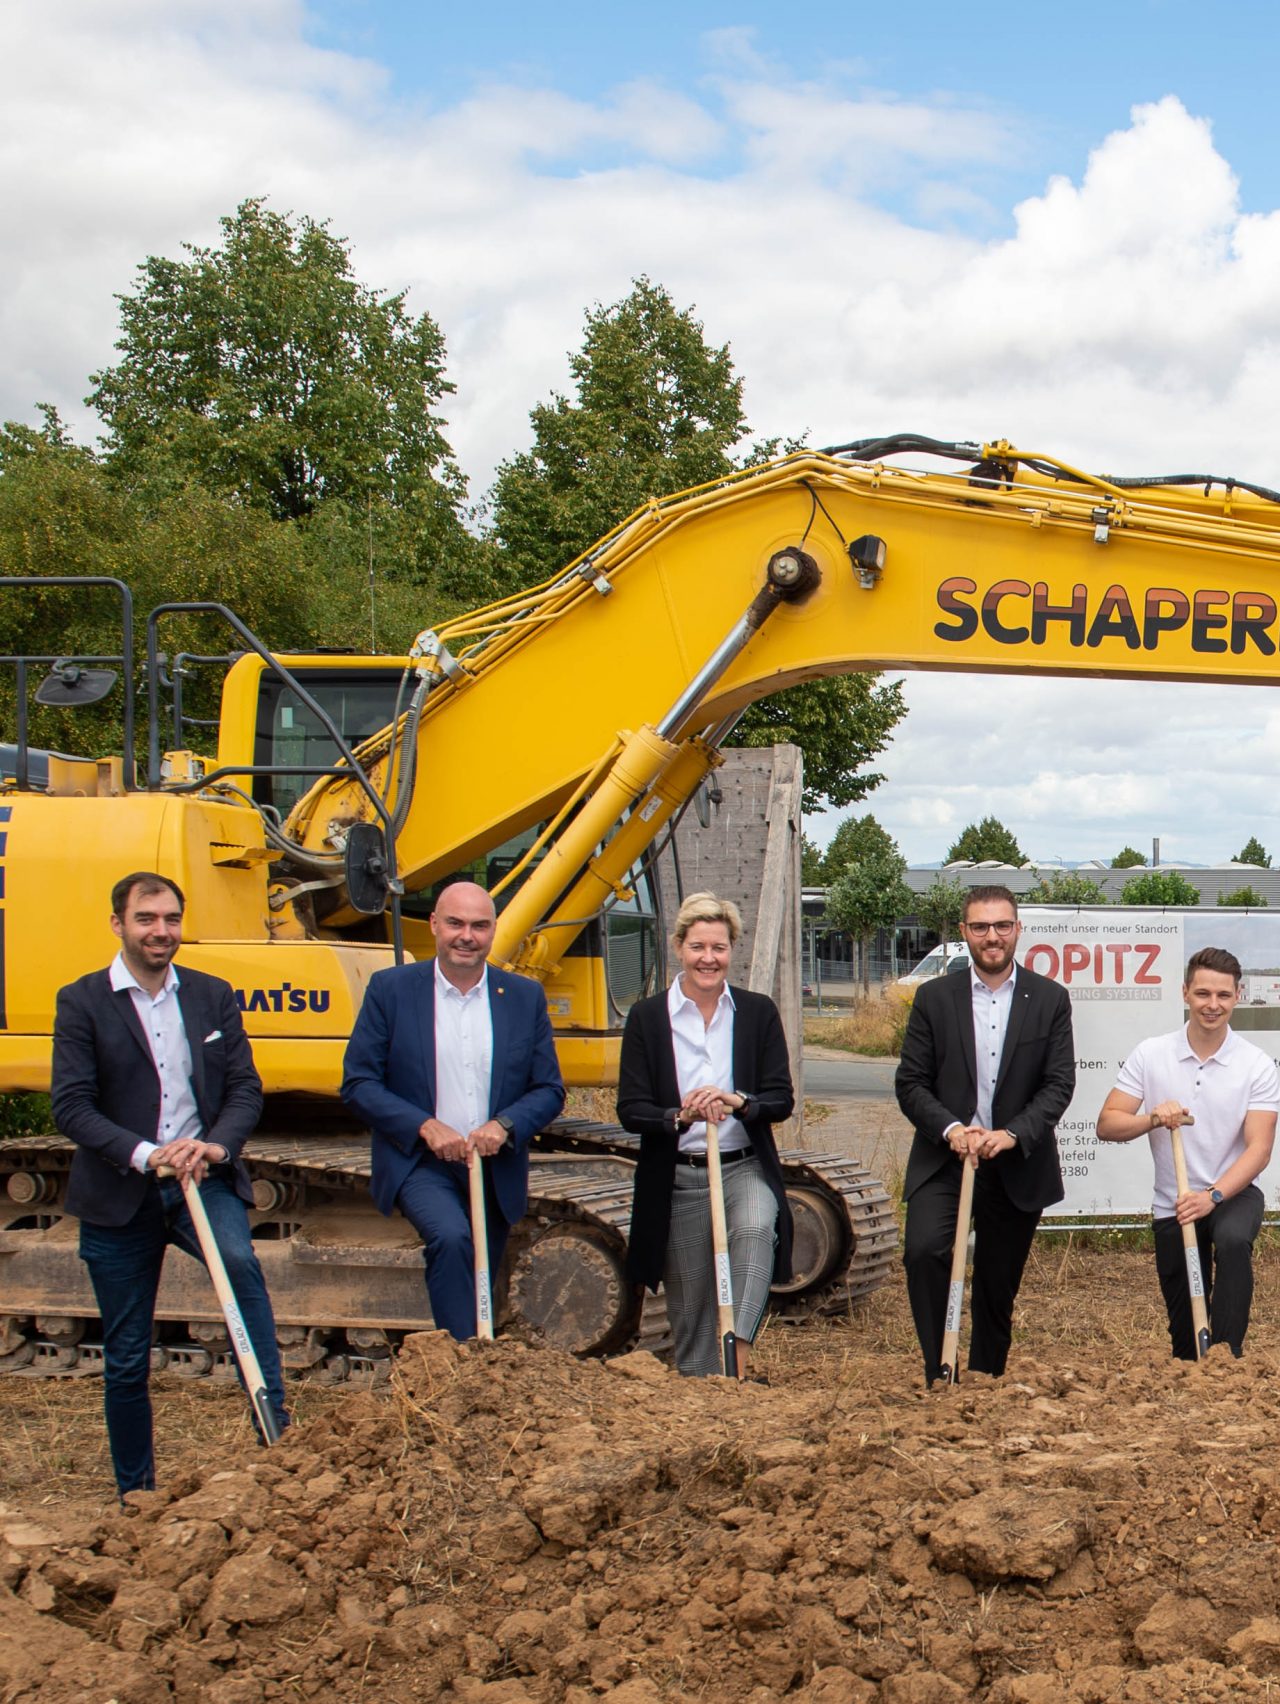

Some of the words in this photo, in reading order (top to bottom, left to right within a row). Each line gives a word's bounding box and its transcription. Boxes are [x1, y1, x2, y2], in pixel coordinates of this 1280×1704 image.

[1031, 924, 1068, 933] ensteht
[1071, 926, 1099, 934] unser
[1102, 926, 1131, 934] neuer
[1135, 924, 1178, 934] Standort
[1024, 944, 1162, 985] OPITZ
[1070, 988, 1100, 1000] GING
[1106, 988, 1159, 1000] SYSTEMS
[720, 1278, 729, 1304] GERLACH
[1192, 1270, 1201, 1295] GERLACH
[480, 1294, 489, 1320] GERLACH
[946, 1305, 955, 1331] GERLACH
[234, 1326, 250, 1354] GERLACH
